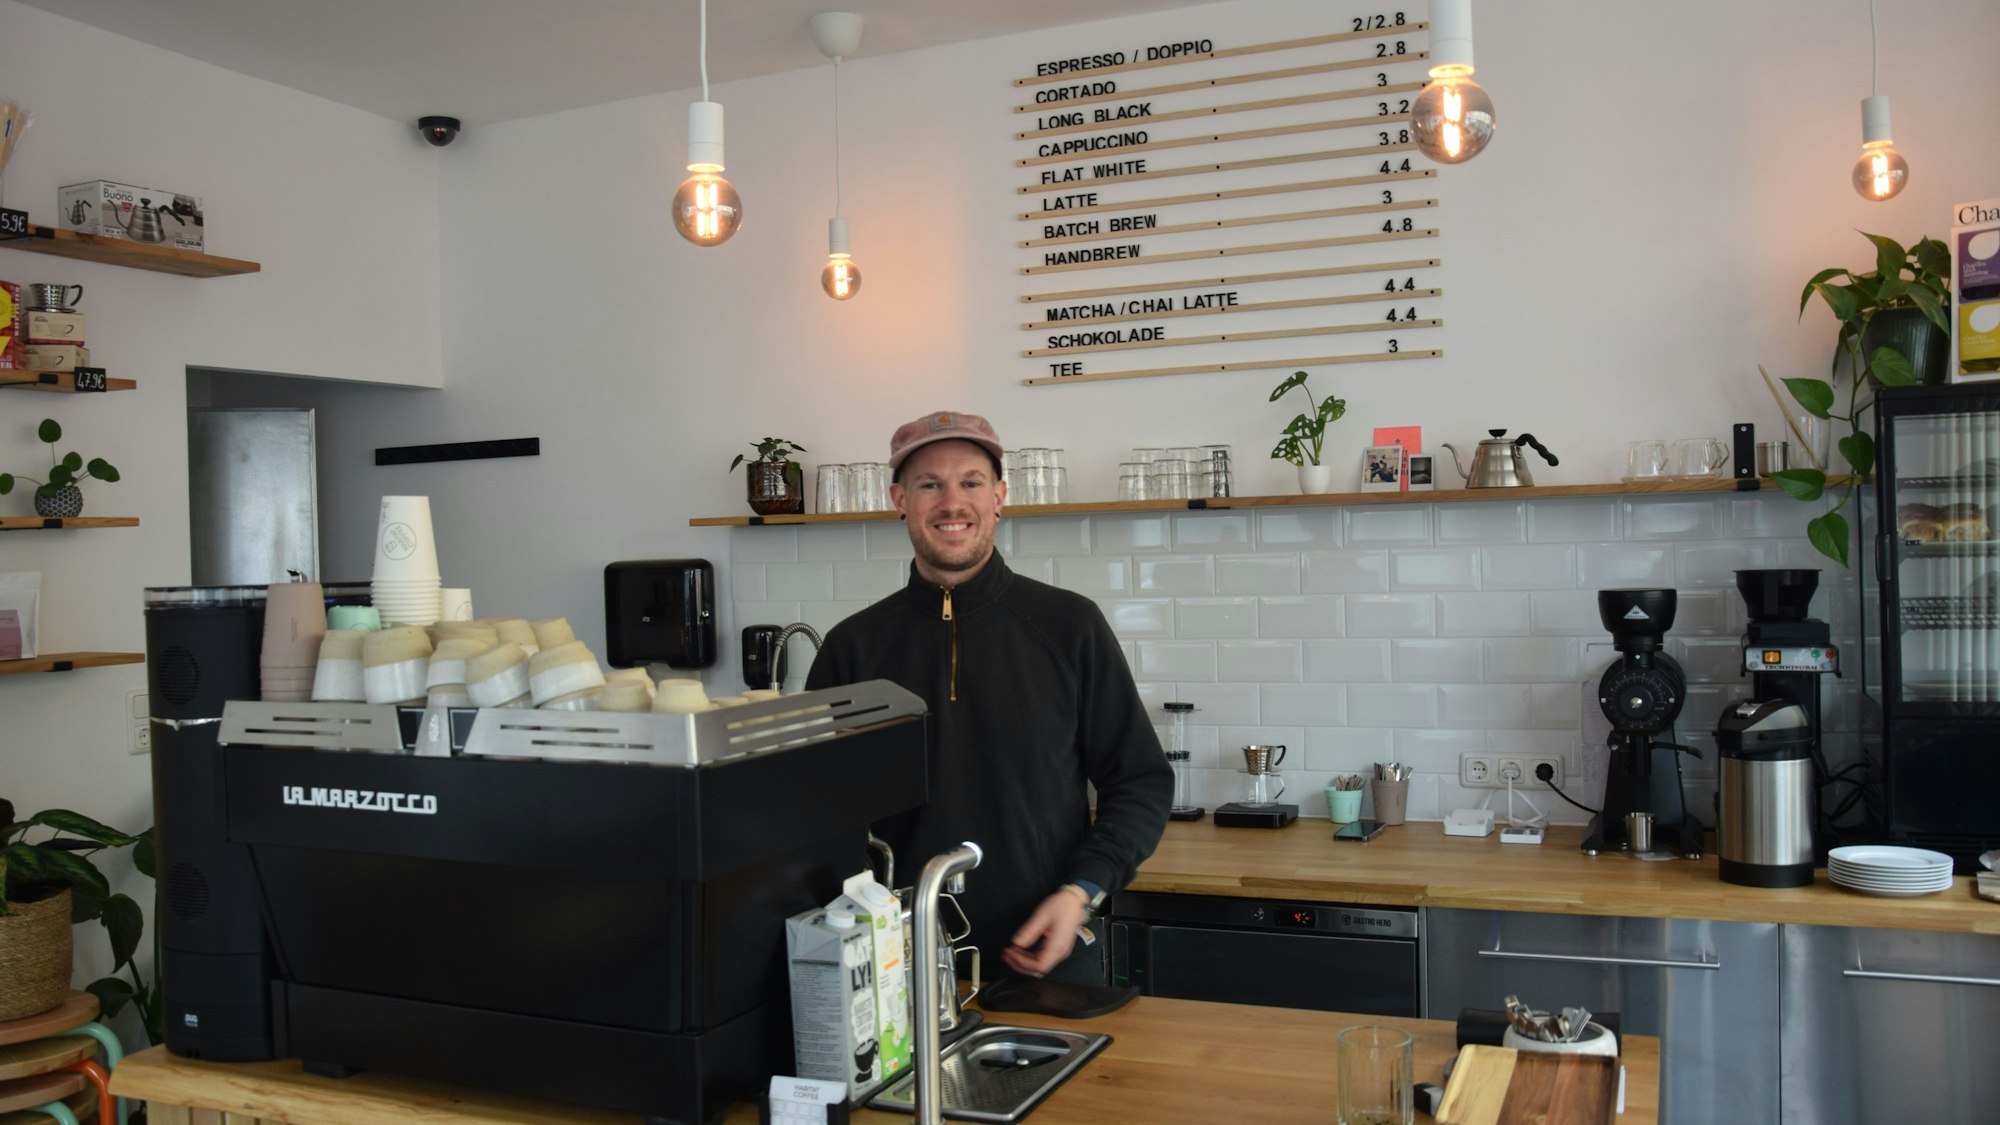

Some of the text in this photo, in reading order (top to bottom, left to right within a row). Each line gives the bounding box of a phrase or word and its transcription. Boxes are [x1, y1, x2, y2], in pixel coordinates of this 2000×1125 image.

[1353, 12, 1405, 32] 2/2.8
[1037, 39, 1213, 77] ESPRESSO / DOPPIO
[1376, 41, 1406, 58] 2.8
[1377, 73, 1387, 87] 3
[1035, 81, 1116, 104] CORTADO
[1038, 103, 1151, 130] LONG BLACK
[1378, 100, 1409, 116] 3.2
[1038, 131, 1148, 157] CAPPUCCINO
[1379, 129, 1409, 146] 3.8
[1041, 159, 1146, 185] FLAT WHITE
[1380, 158, 1411, 175] 4.4
[103, 188, 134, 203] Buono
[1043, 193, 1098, 211] LATTE
[1382, 190, 1392, 204] 3
[1044, 214, 1156, 239] BATCH BREW
[1382, 217, 1413, 233] 4.8
[1045, 244, 1140, 266] HANDBREW
[1385, 277, 1415, 293] 4.4
[1183, 292, 1238, 310] LATTE
[1386, 307, 1417, 322] 4.4
[1048, 327, 1165, 349] SCHOKOLADE
[1388, 339, 1398, 353] 3
[1050, 362, 1083, 377] TEE
[283, 786, 438, 815] LA MARZOCCO
[1353, 917, 1376, 926] GASTRO
[1376, 918, 1392, 928] HERO
[851, 961, 872, 992] LY!
[793, 1091, 819, 1100] COFFEE
[794, 1085, 820, 1093] HABITAT
